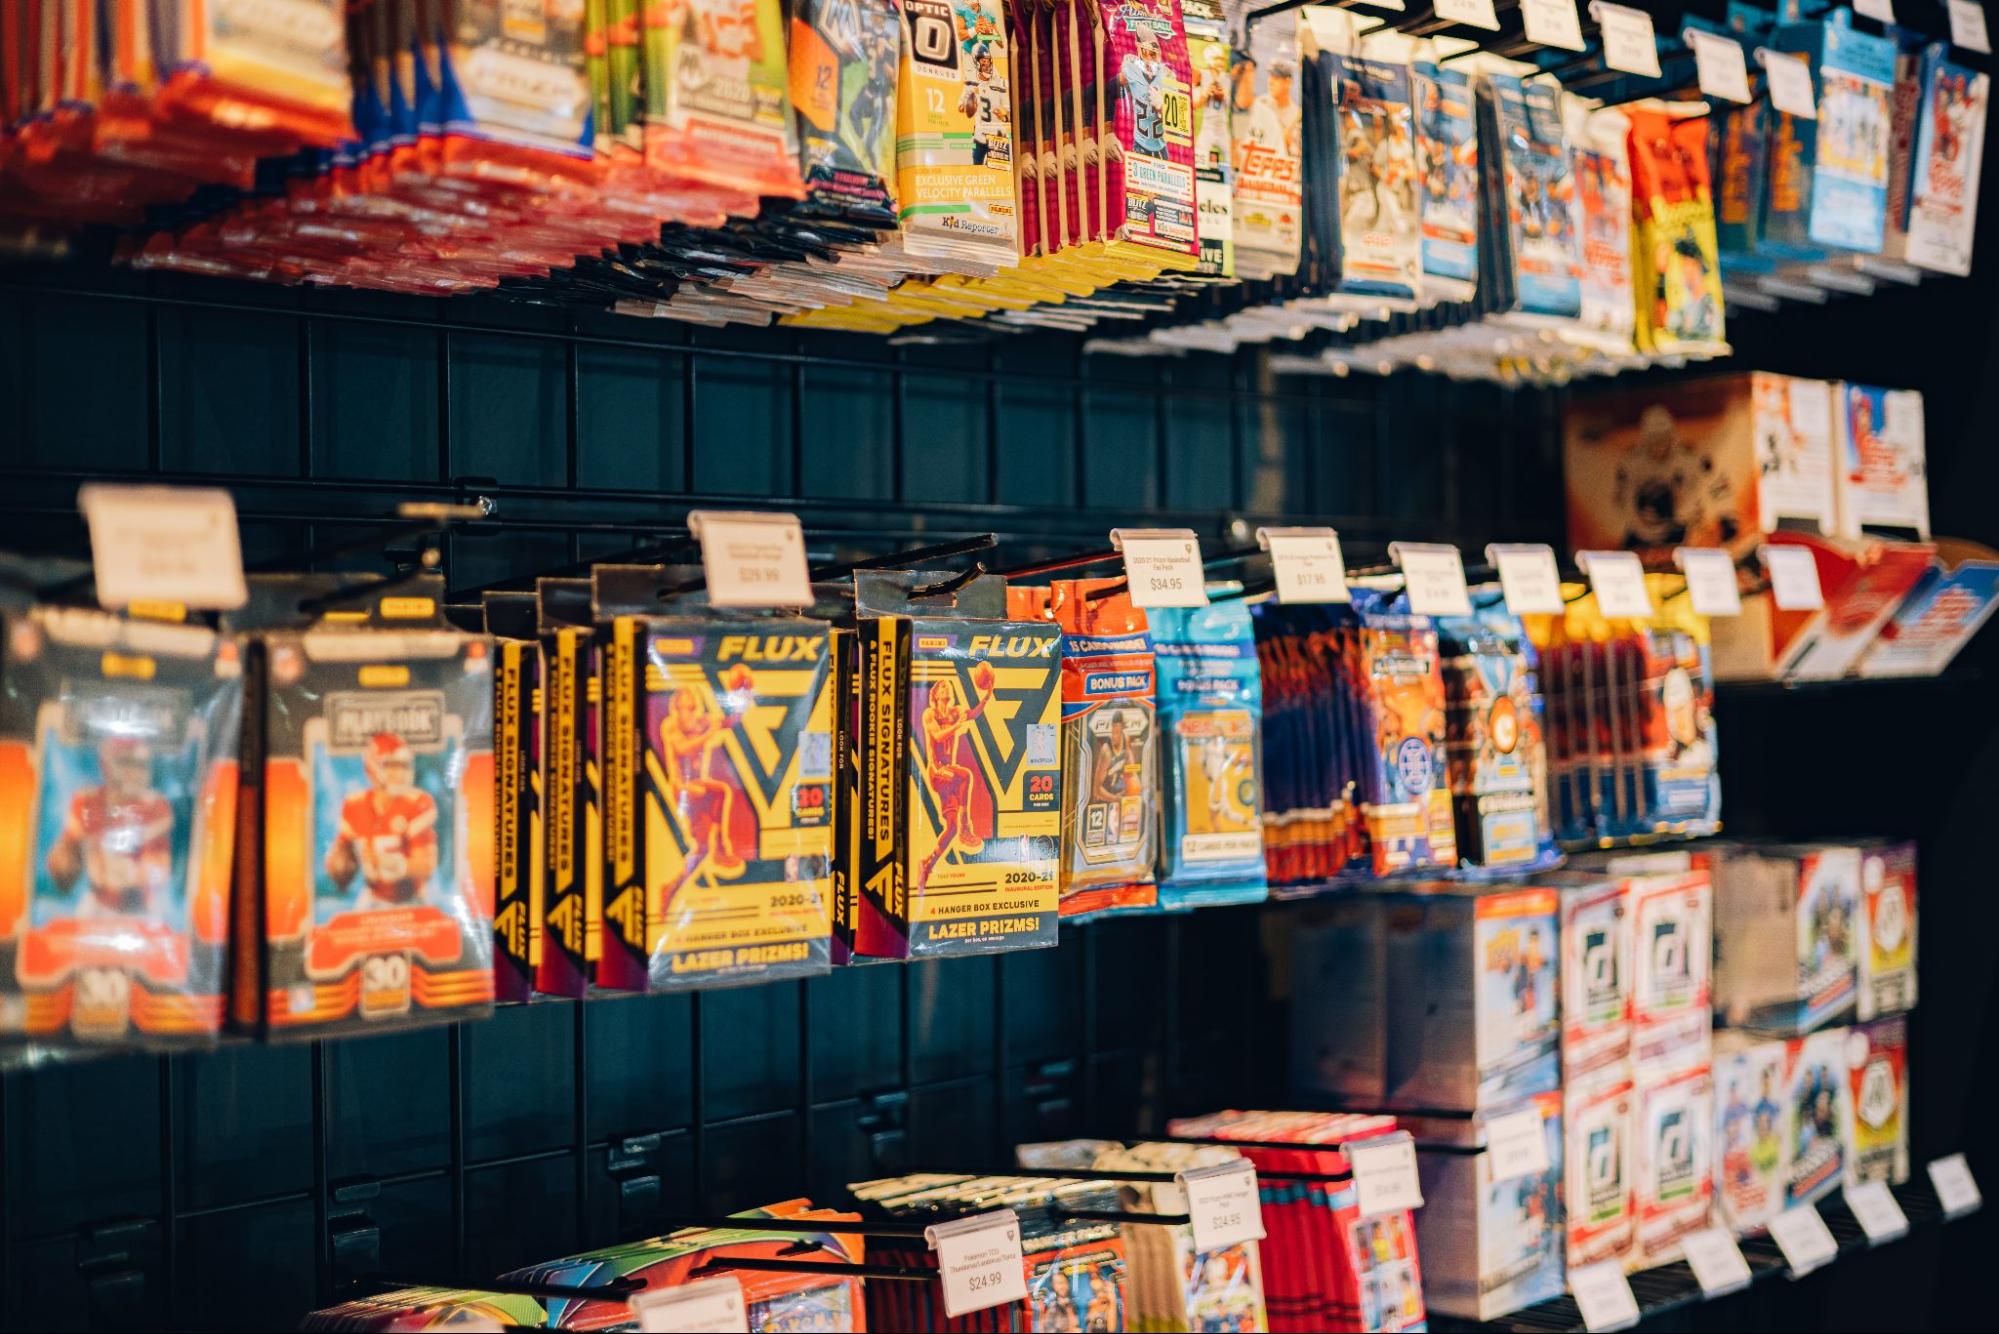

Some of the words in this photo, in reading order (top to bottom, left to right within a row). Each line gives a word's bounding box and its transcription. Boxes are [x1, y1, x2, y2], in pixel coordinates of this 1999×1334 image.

[905, 0, 949, 16] OPTIC
[926, 87, 946, 113] 12
[1164, 92, 1178, 128] 20
[916, 174, 963, 187] EXCLUSIVE
[965, 175, 997, 186] GREEN
[917, 187, 960, 200] VELOCITY
[963, 184, 1012, 199] PARALLELS
[960, 221, 1000, 234] Reporter
[1150, 577, 1183, 591] $34.95
[717, 636, 824, 662] FLUX
[968, 635, 1056, 658] FLUX
[1069, 640, 1078, 652] 15
[868, 653, 877, 691] FLUX
[880, 640, 893, 697] FLUX
[561, 656, 572, 715] FLUX
[1090, 677, 1124, 691] BONUS
[1126, 674, 1146, 689] PACK
[505, 669, 516, 725] FLUX
[867, 693, 876, 746] ROOKIE
[879, 704, 892, 842] SIGNATURES
[1030, 775, 1053, 793] 20
[560, 725, 571, 870] SIGNATURES
[867, 747, 876, 840] SIGNATURES!
[1029, 793, 1054, 801] CARDS
[504, 735, 516, 879] SIGNATURES
[1091, 810, 1103, 828] 12
[893, 861, 904, 918] FLUX
[1005, 872, 1054, 884] 2020-21
[836, 870, 845, 925] FLUX
[930, 907, 936, 915] 4
[938, 903, 972, 915] HANGER
[973, 902, 991, 912] BOX
[992, 899, 1040, 910] EXCLUSIVE
[928, 920, 977, 941] LAZER
[979, 916, 1041, 936] PRIZMS!
[672, 949, 733, 974] LAZER
[736, 942, 809, 966] PRIZMS!
[969, 1271, 1002, 1291] $24.99
